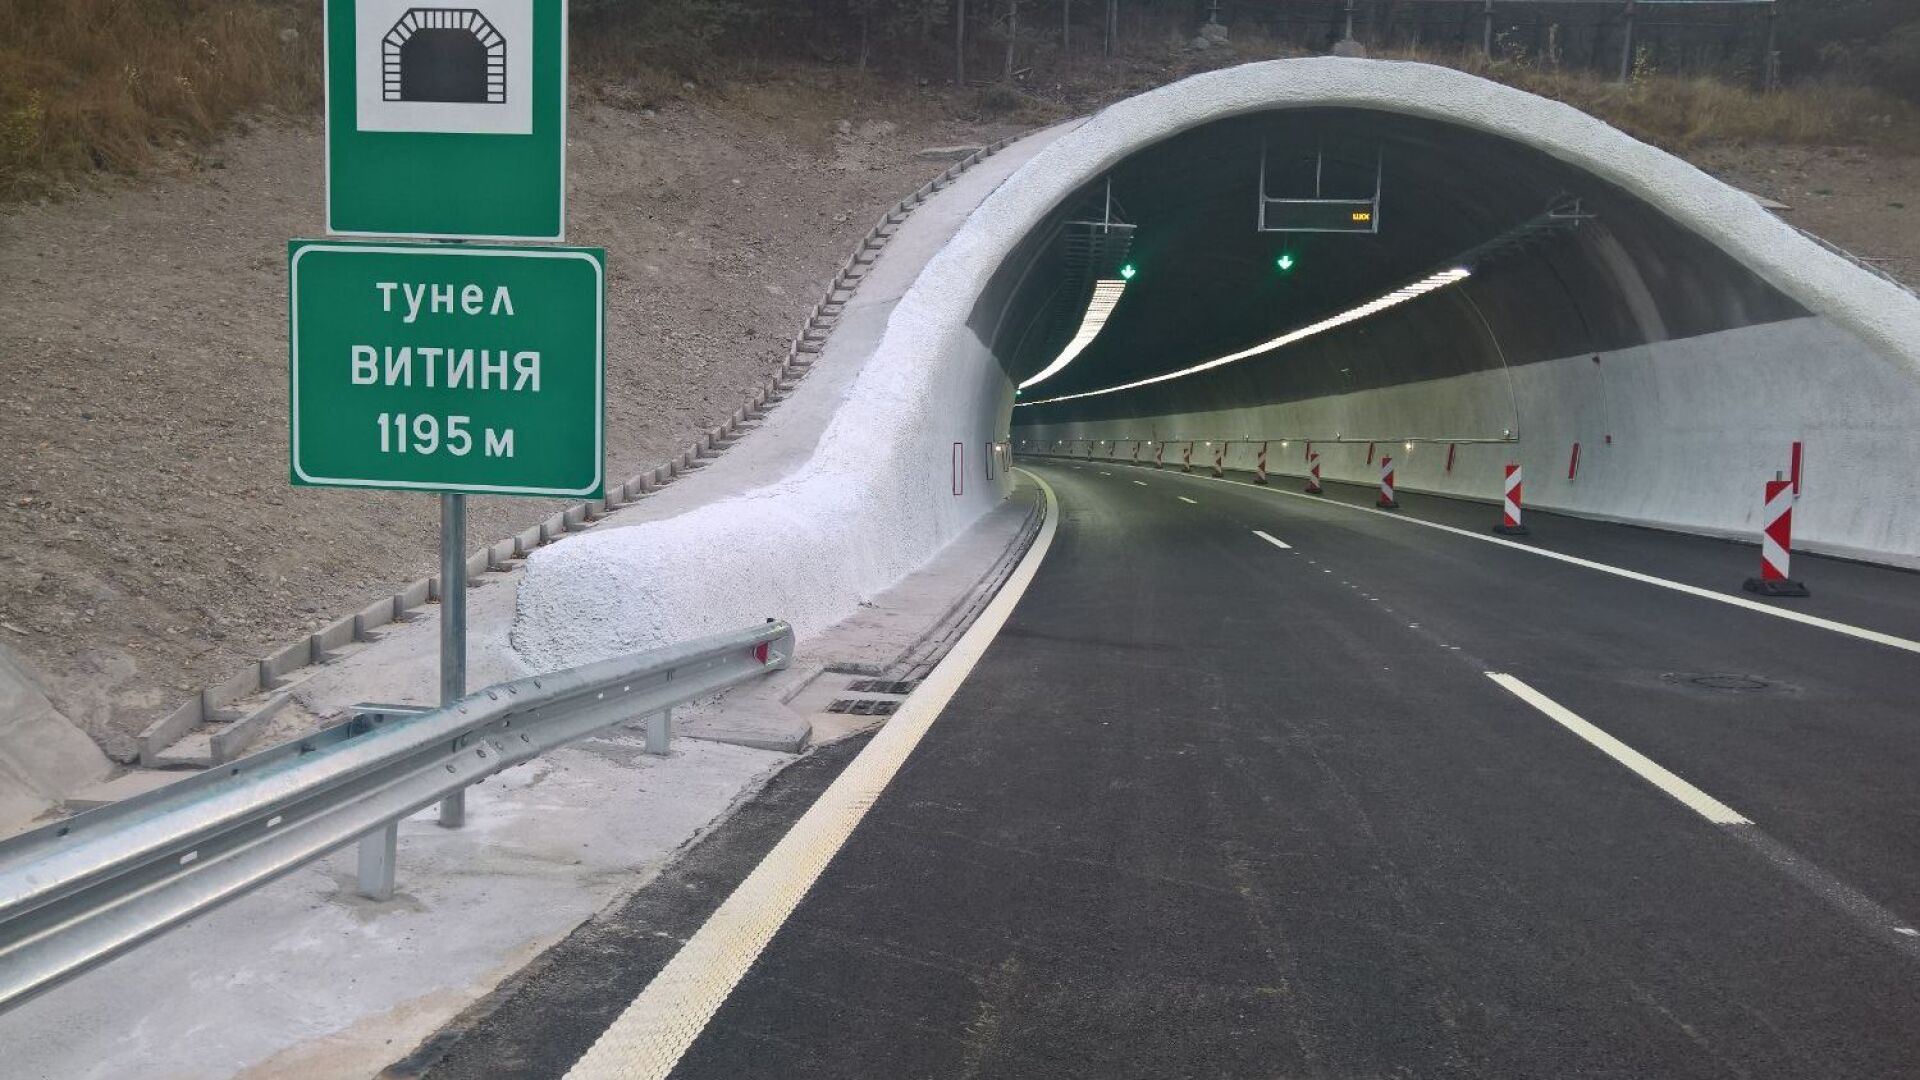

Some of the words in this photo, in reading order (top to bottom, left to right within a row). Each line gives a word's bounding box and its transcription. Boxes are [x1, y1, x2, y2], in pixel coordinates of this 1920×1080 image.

[376, 282, 515, 323] тунел
[351, 345, 541, 392] ВИТИНЯ
[376, 412, 473, 456] 1195
[484, 428, 514, 458] м
